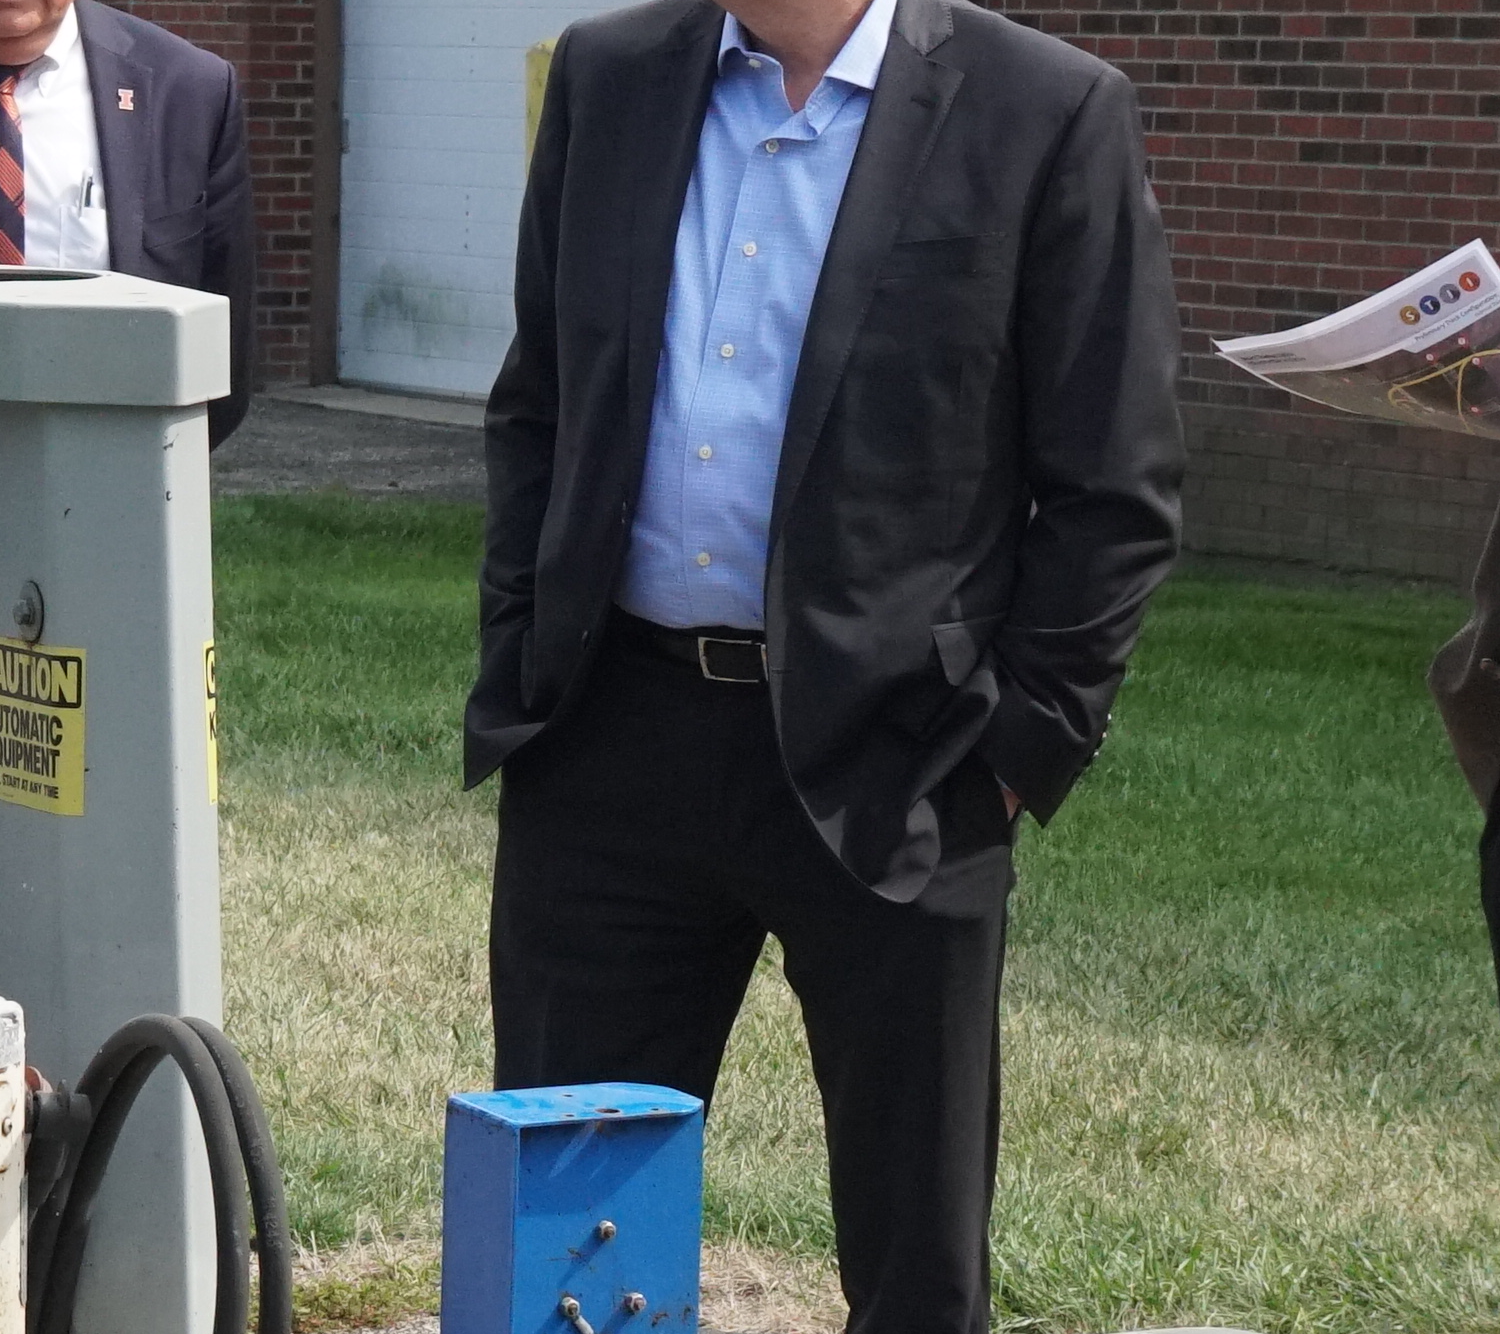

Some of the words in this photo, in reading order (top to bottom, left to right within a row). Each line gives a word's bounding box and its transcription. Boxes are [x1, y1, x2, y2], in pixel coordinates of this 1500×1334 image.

[2, 773, 20, 789] START
[21, 779, 28, 792] AT
[29, 781, 42, 794] ANY
[43, 784, 59, 799] TIME
